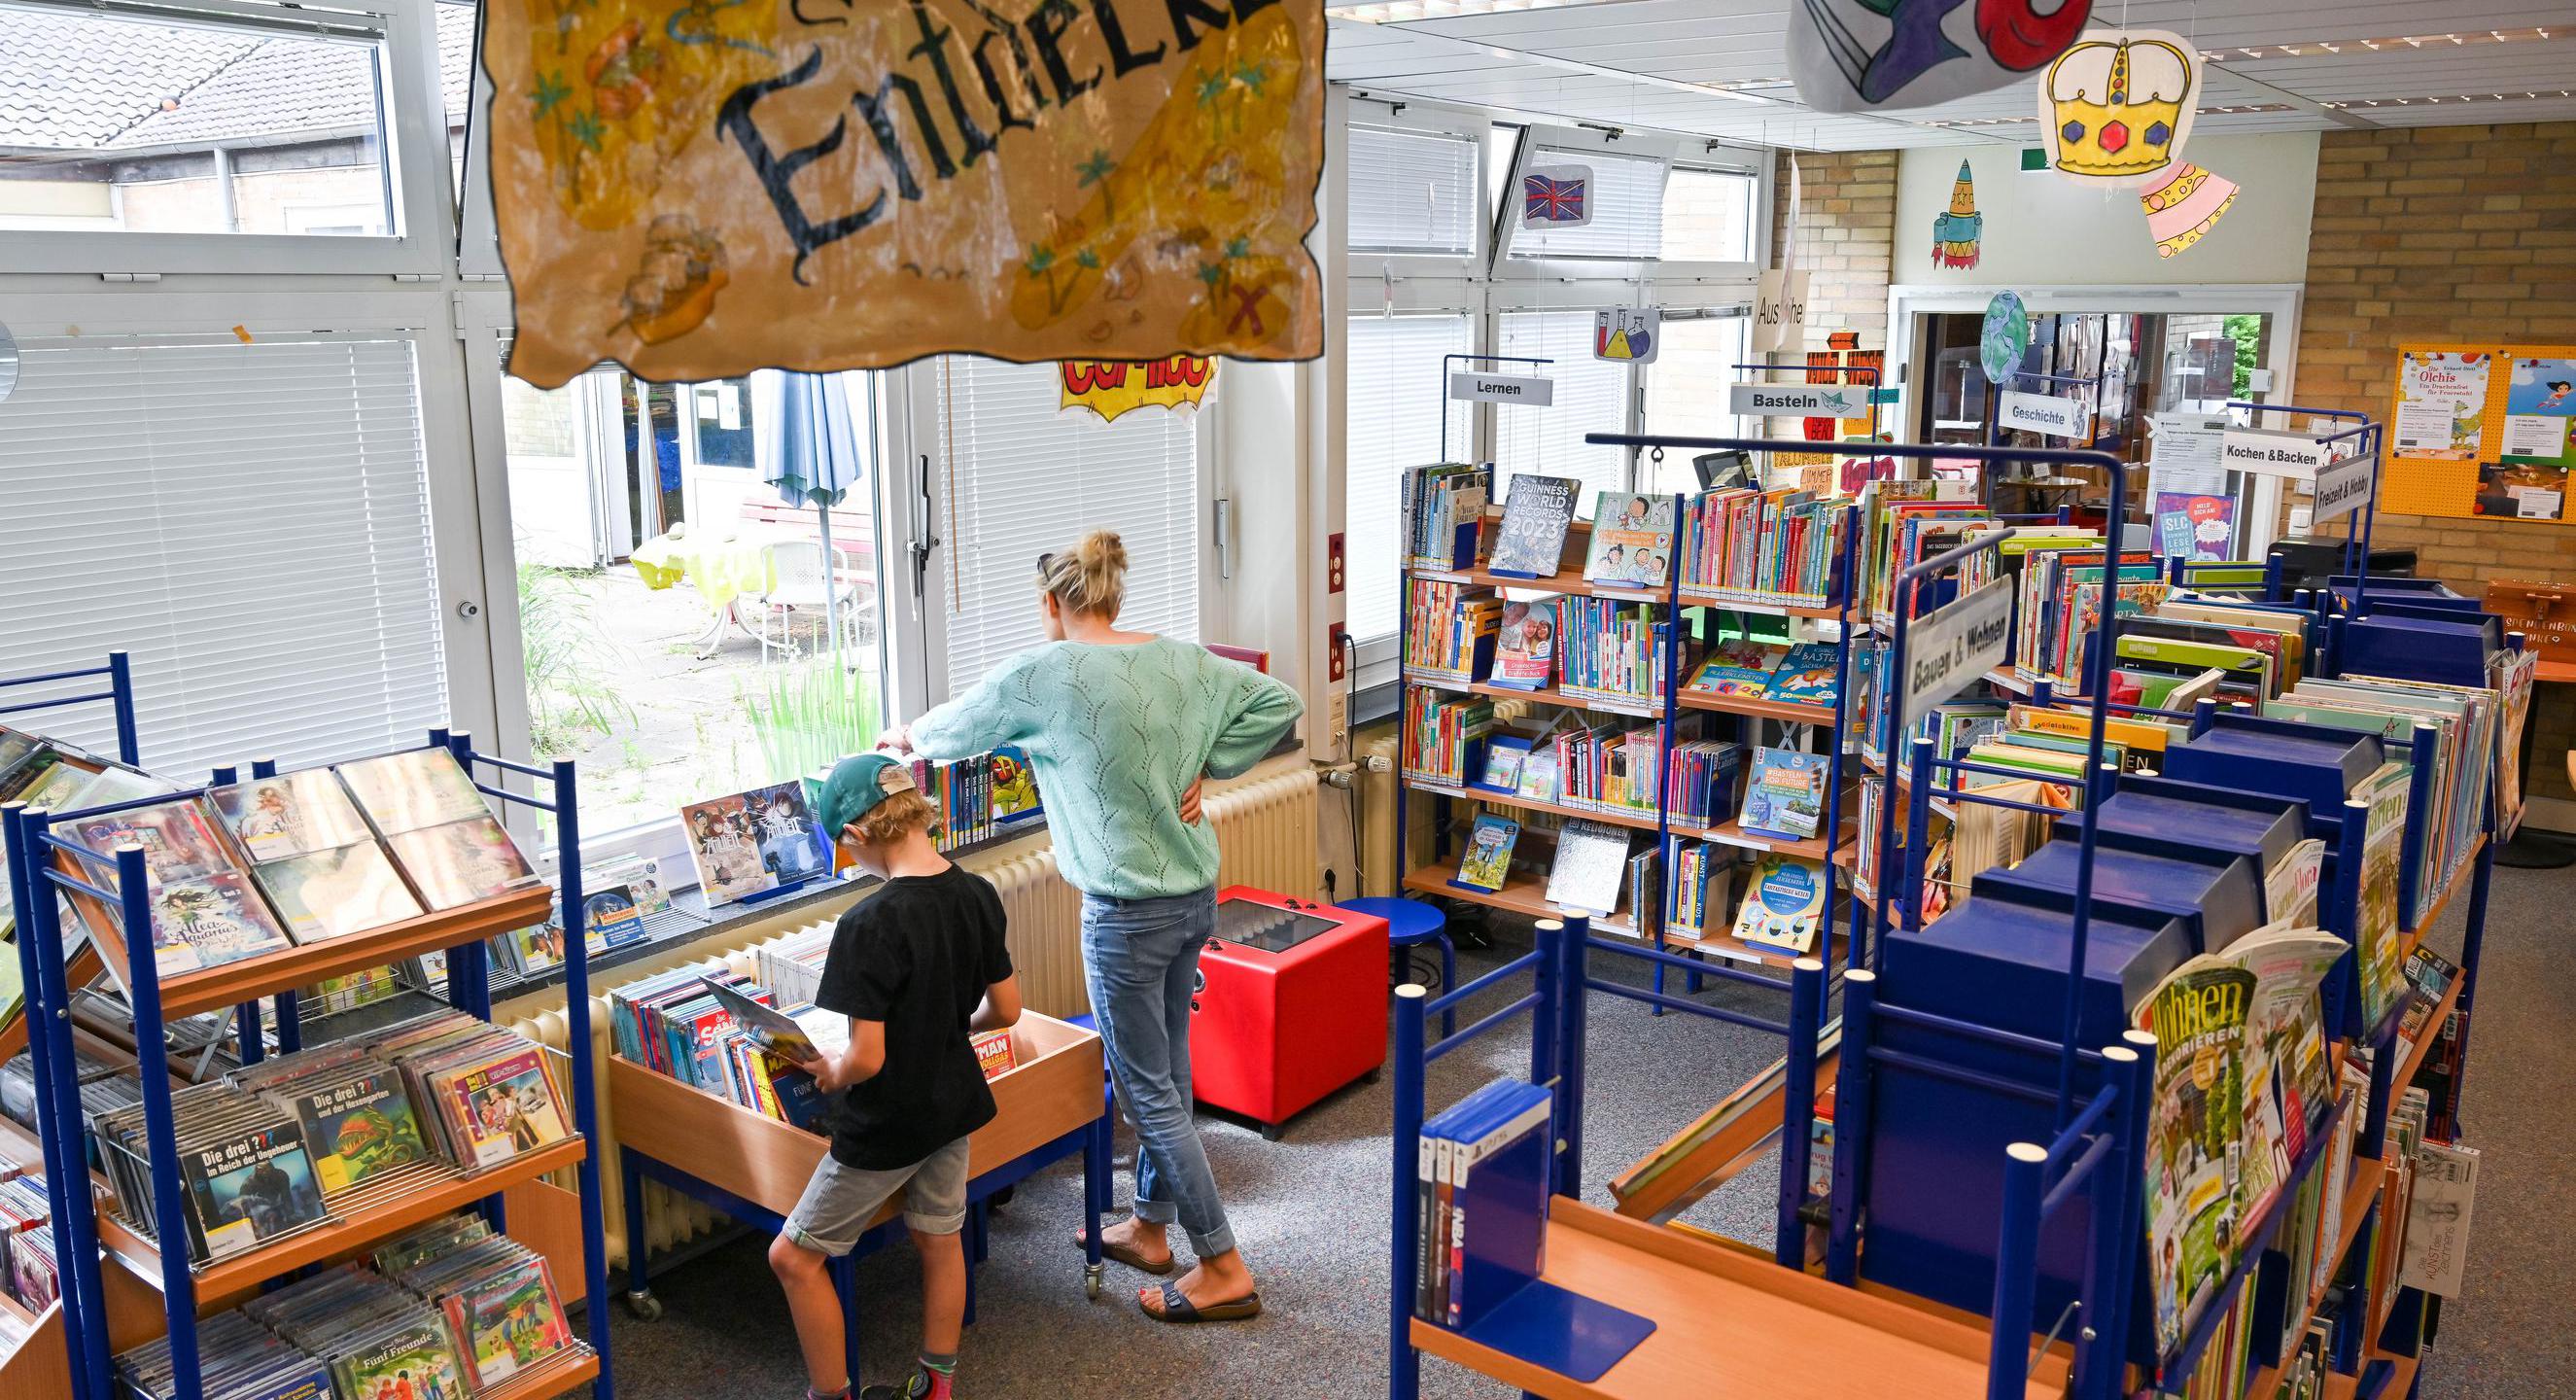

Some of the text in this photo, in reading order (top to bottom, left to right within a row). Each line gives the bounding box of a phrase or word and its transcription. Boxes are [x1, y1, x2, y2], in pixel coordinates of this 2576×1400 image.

[1758, 297, 1803, 325] Ausihe
[2419, 370, 2456, 383] Olchis
[1477, 380, 1521, 396] Lernen
[1753, 394, 1818, 408] Basteln
[2012, 405, 2065, 425] Geschichte
[2227, 444, 2265, 461] Kochen
[1519, 482, 1569, 497] GUINNESS
[2318, 474, 2369, 509] Freizeit & Hobby
[1517, 494, 1566, 508] WORLD
[1513, 506, 1564, 519] RECORDS
[1508, 516, 1559, 539] 2023
[2165, 515, 2188, 531] SLC
[2168, 538, 2190, 547] LESE
[1912, 616, 2006, 695] Bauen & Wohnen
[1780, 778, 1807, 788] FUTURE
[1581, 823, 1629, 838] RELIGIONEN
[174, 925, 239, 946] Aquarius
[182, 921, 224, 937] Alea
[2151, 981, 2243, 1061] Wohnen
[313, 1077, 378, 1109] Die drei ???
[318, 1090, 390, 1119] und der Hexengarten
[201, 1131, 273, 1167] Die drei ???
[206, 1140, 297, 1178] Im Reich der Ungeheuer
[1451, 1210, 1465, 1248] NBA
[2425, 1245, 2440, 1280] KUNST
[364, 1332, 434, 1369] Fünf Freunde
